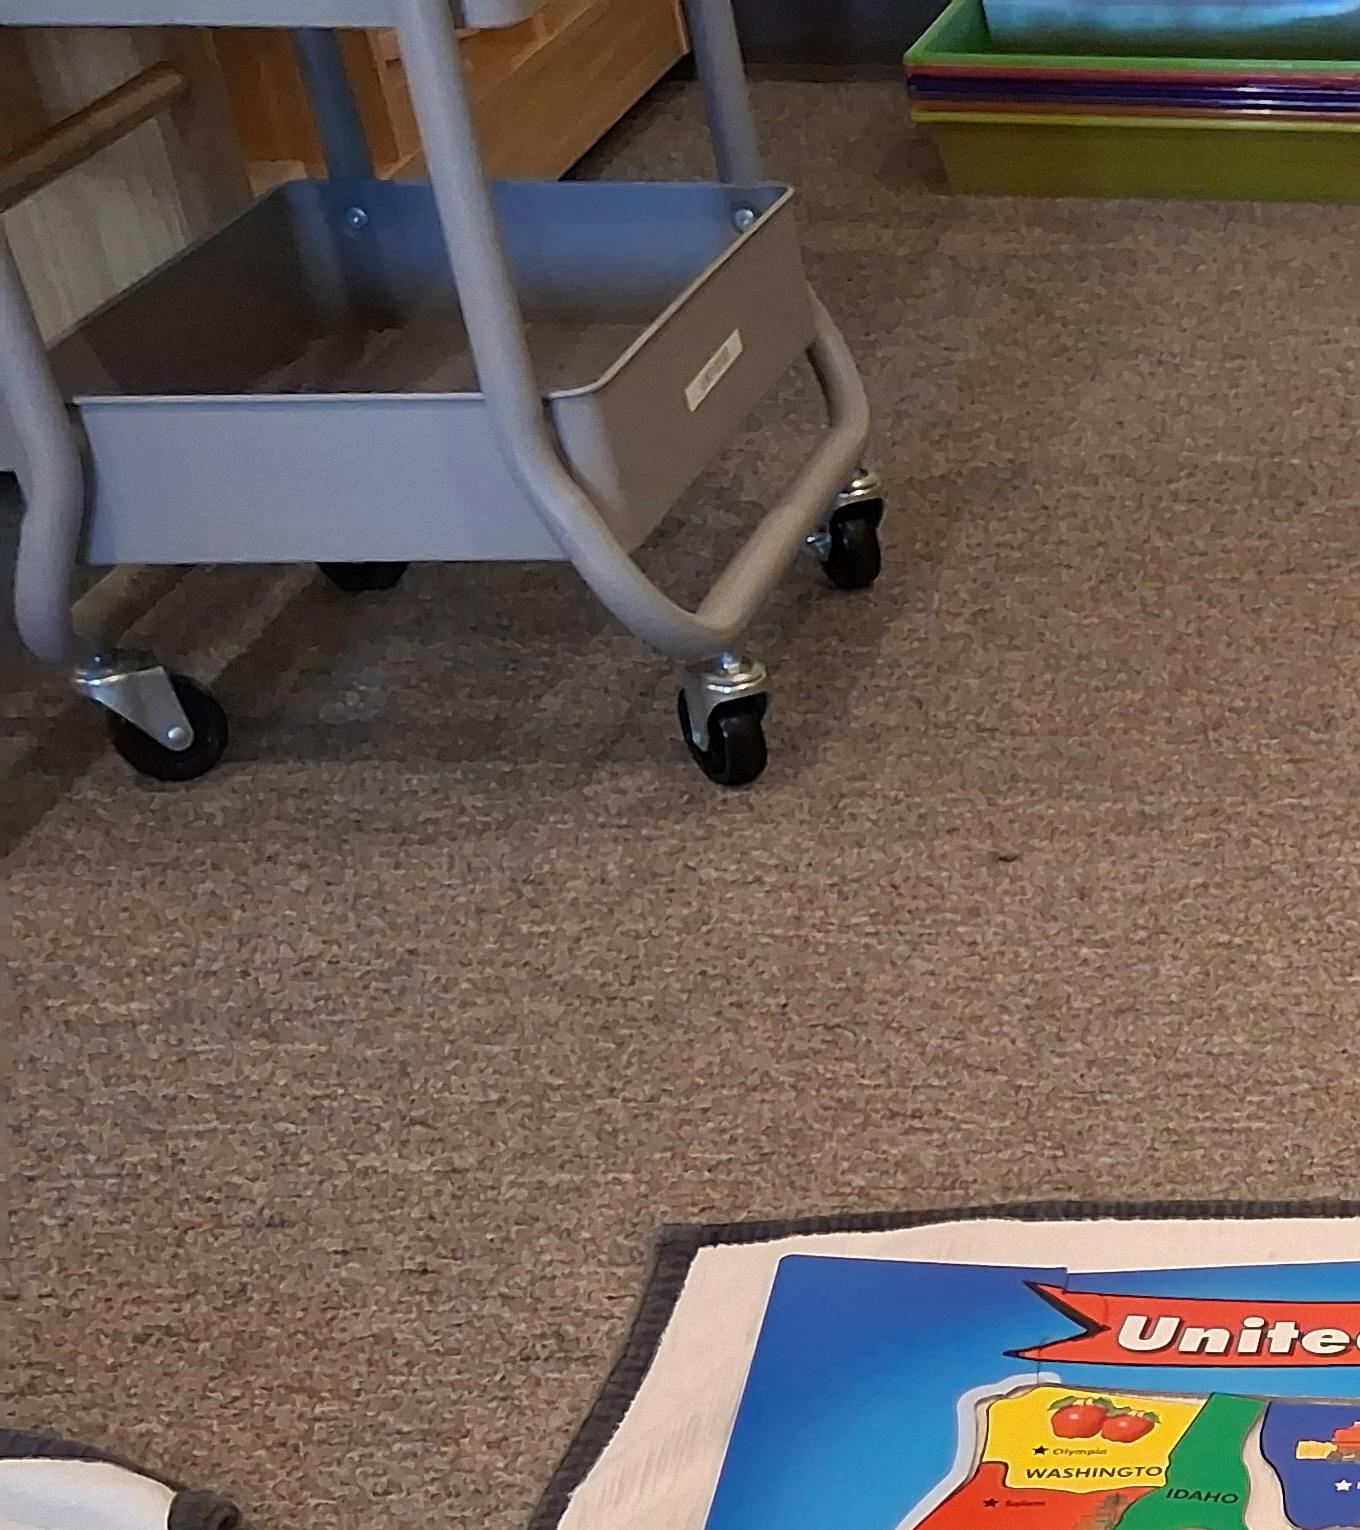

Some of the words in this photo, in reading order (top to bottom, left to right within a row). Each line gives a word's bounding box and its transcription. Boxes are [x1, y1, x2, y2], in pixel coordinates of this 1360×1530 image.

[1052, 1447, 1108, 1457] Olympia
[1026, 1465, 1163, 1479] WASHINGTO
[1166, 1487, 1239, 1504] IDAHO
